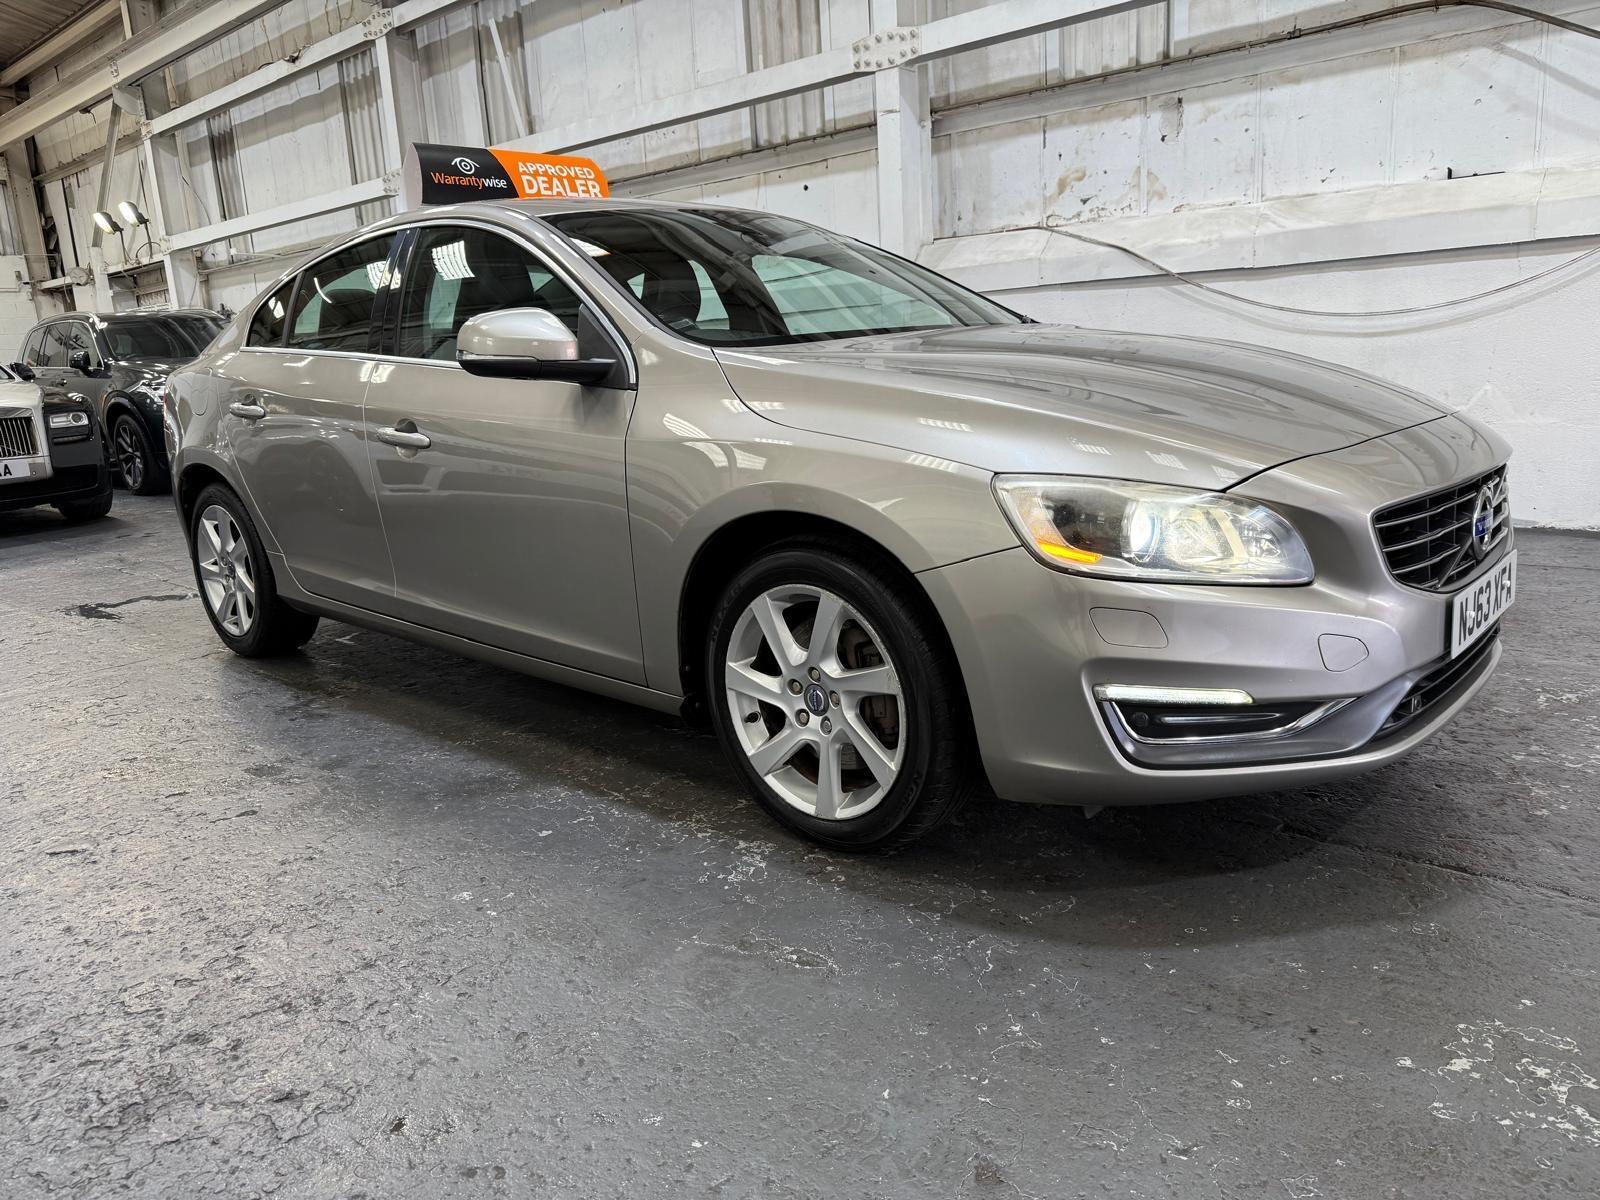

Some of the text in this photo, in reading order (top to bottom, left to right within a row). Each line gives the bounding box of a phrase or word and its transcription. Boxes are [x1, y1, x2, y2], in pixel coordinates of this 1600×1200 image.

[518, 161, 595, 179] APPROVED
[431, 172, 507, 190] Warrantywise
[521, 174, 602, 198] DEALER
[1459, 562, 1512, 646] NJ63 XFA
